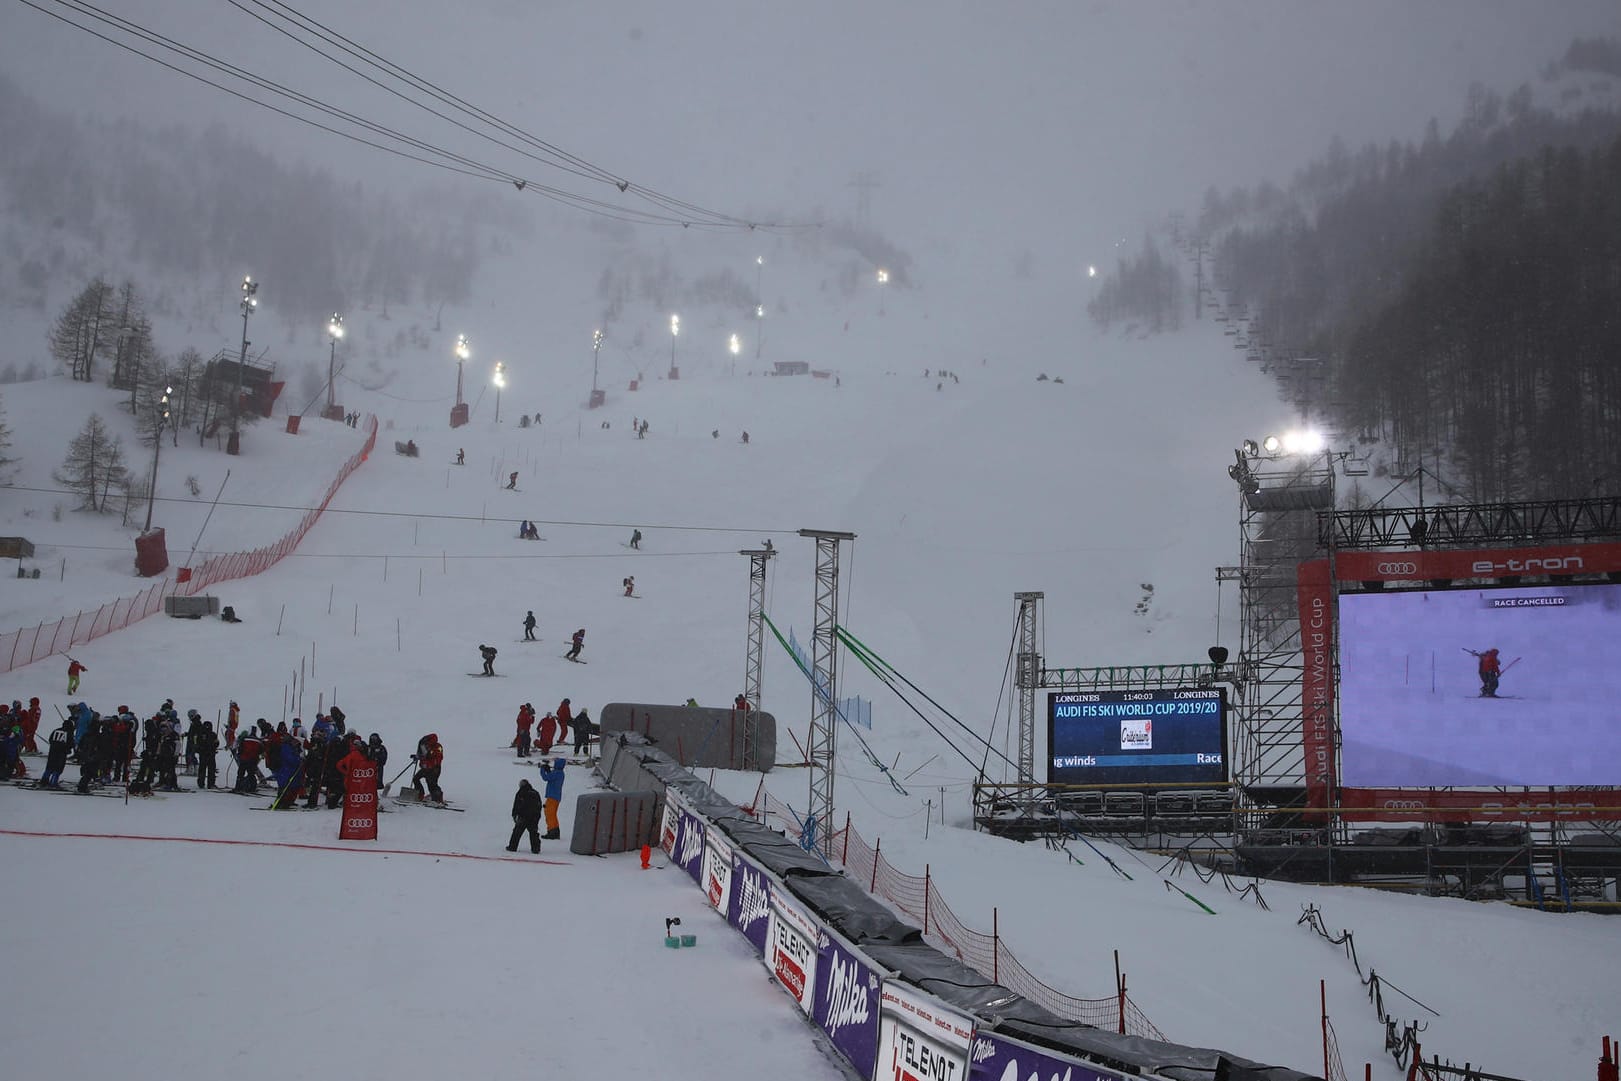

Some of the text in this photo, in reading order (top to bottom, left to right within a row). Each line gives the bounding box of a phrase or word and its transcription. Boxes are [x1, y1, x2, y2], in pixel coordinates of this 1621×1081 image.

[1472, 557, 1583, 572] e-tron
[1494, 598, 1564, 607] RACE CANCELLED
[1311, 598, 1325, 628] Cup
[1312, 633, 1324, 683] World
[1055, 690, 1220, 703] LONGINES 11:40:03 LONGINES
[1056, 702, 1217, 717] AUDI FIS SKI WORLD CUP 2019/20
[1315, 713, 1326, 740] FIS
[53, 730, 67, 743] ITA
[1064, 755, 1096, 766] winds
[825, 949, 869, 1038] Milka
[900, 1032, 955, 1081] TELENOT
